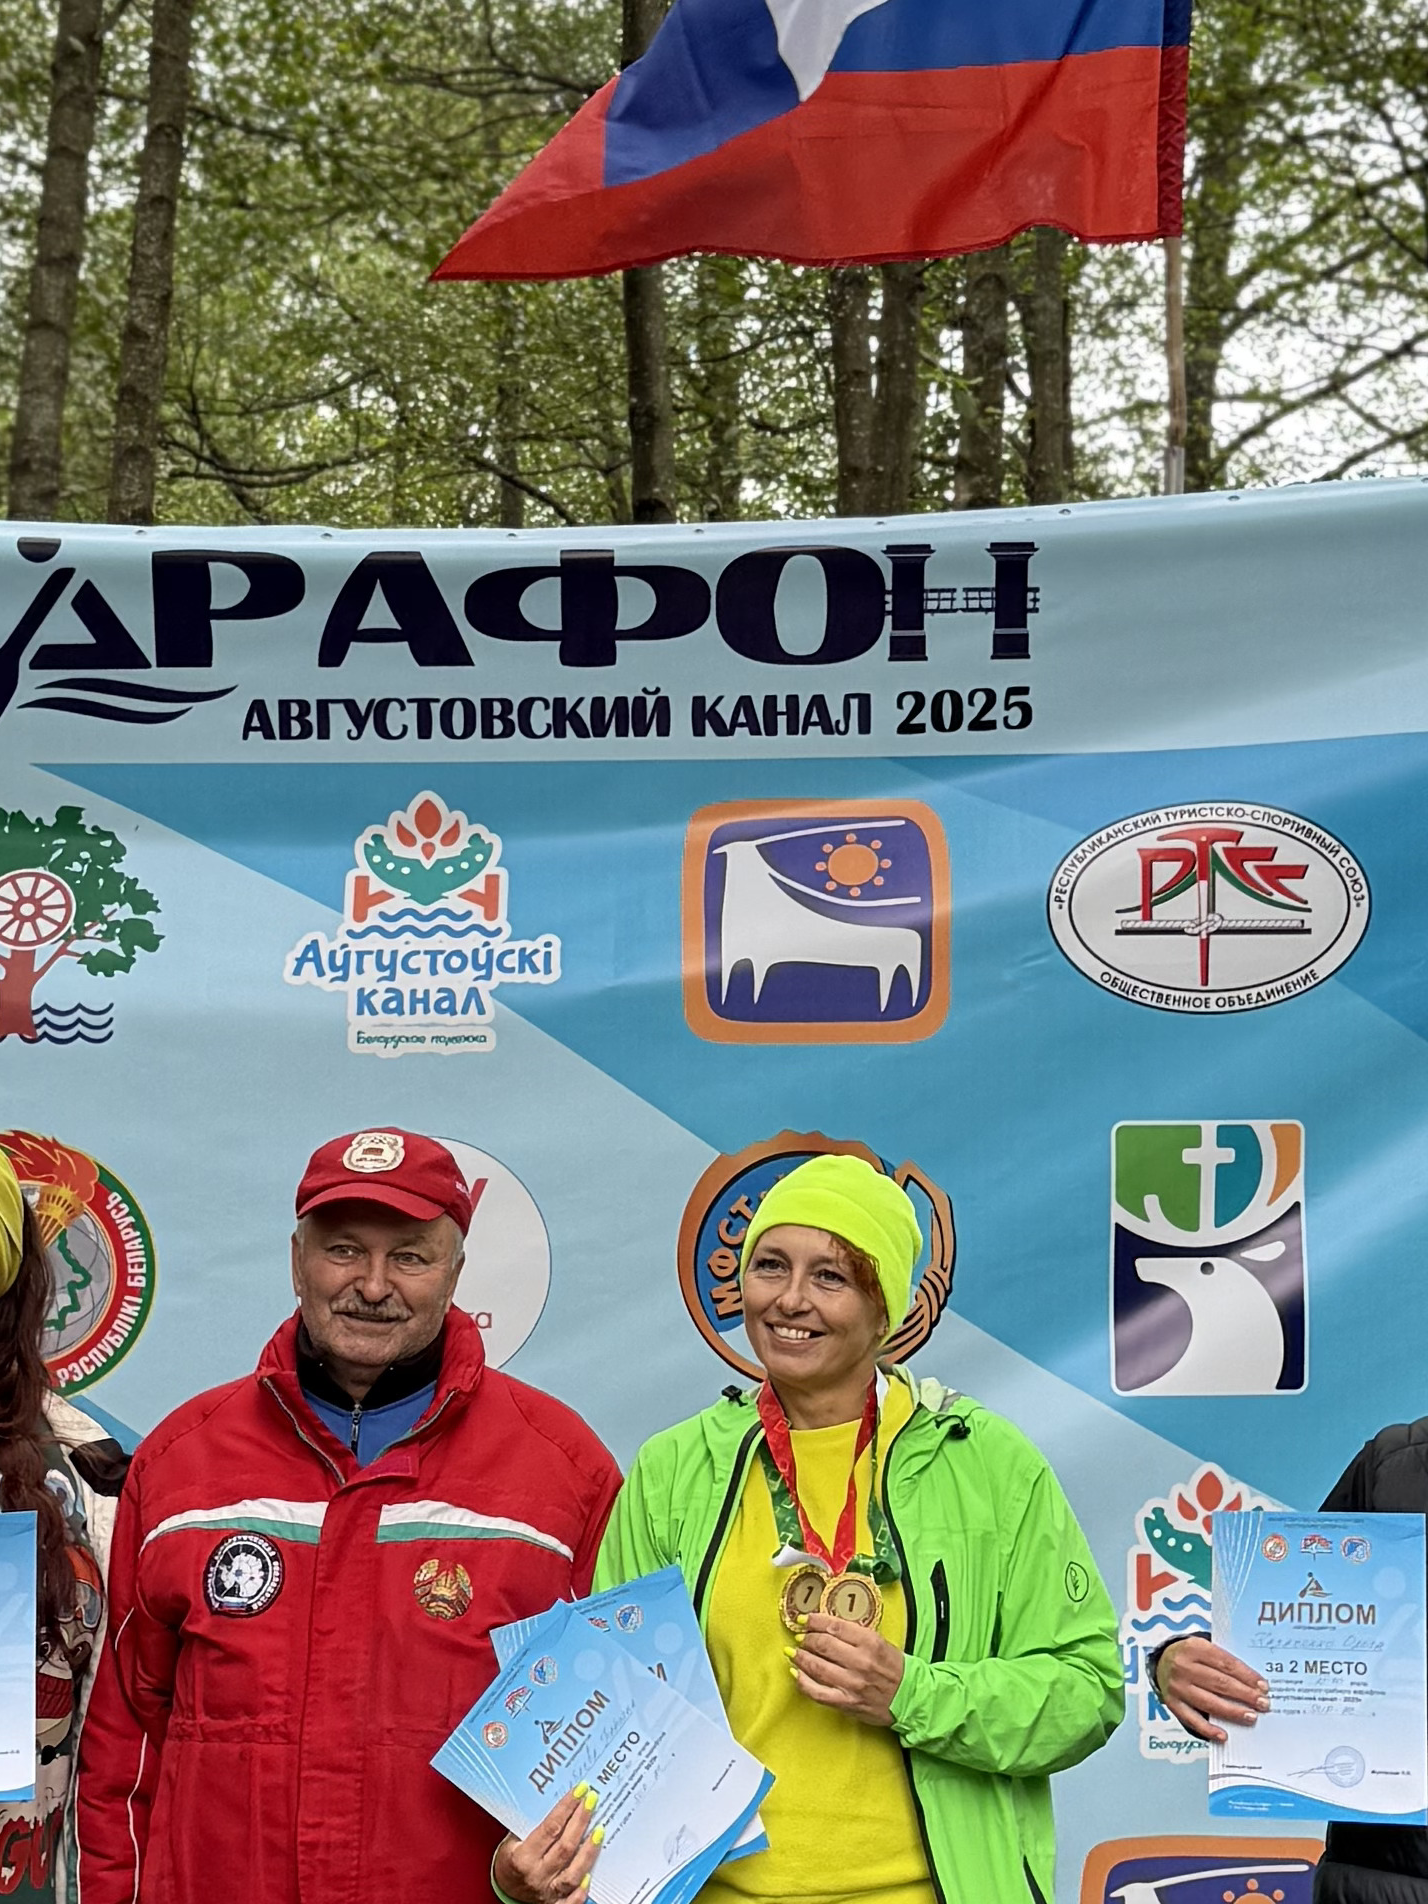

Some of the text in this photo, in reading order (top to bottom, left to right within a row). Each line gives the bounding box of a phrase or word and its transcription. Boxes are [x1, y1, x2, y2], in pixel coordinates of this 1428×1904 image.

[242, 685, 1034, 741] АВГУСТОВСКИЙ КАНАЛ 2025
[1164, 806, 1341, 859] ТУРИСТСКО-СПОРТИВНЫЙ
[292, 939, 553, 983] Аўгустоўскі
[356, 986, 486, 1016] канал
[1099, 968, 1320, 1009] ОБЩЕСТВЕННОЕ ОБЪЕДИНЕНИЕ
[56, 1191, 147, 1388] РЭСПУБЛІКІ БЕЛАРУСЬ
[847, 1593, 857, 1613] 1
[1257, 1601, 1376, 1626] ДИПЛОМ
[1265, 1660, 1368, 1676] за 2 МЕСТО
[528, 1689, 611, 1794] ДИПЛОМ
[597, 1731, 641, 1786] МЕСТО
